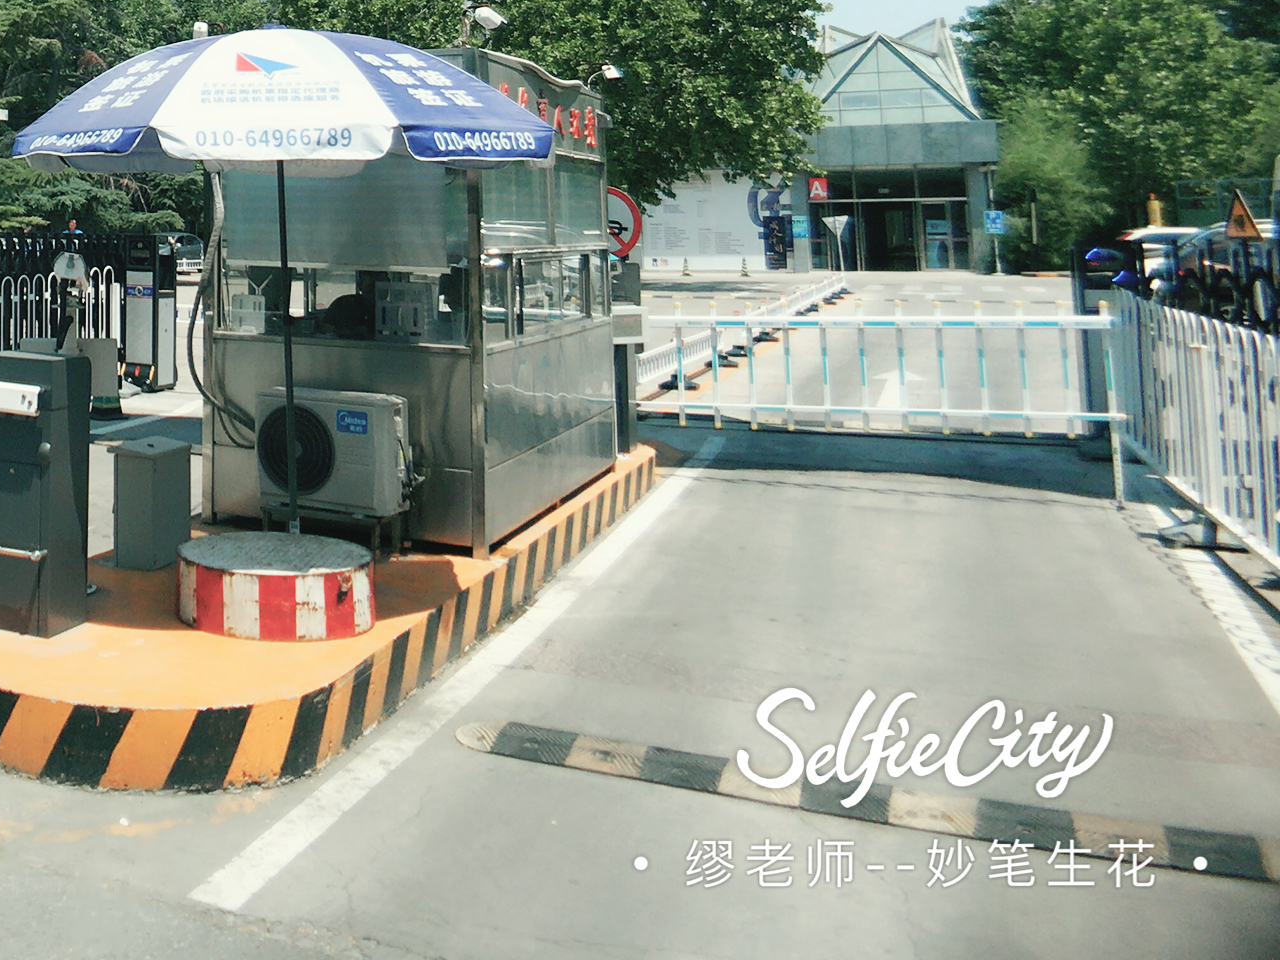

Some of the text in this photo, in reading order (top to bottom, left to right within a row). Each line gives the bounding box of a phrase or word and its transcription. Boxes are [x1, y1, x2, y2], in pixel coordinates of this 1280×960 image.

[407, 87, 484, 108] 签证
[29, 127, 124, 150] 010-64966789
[195, 127, 352, 148] 010-64966789
[433, 131, 536, 152] 010-64966789
